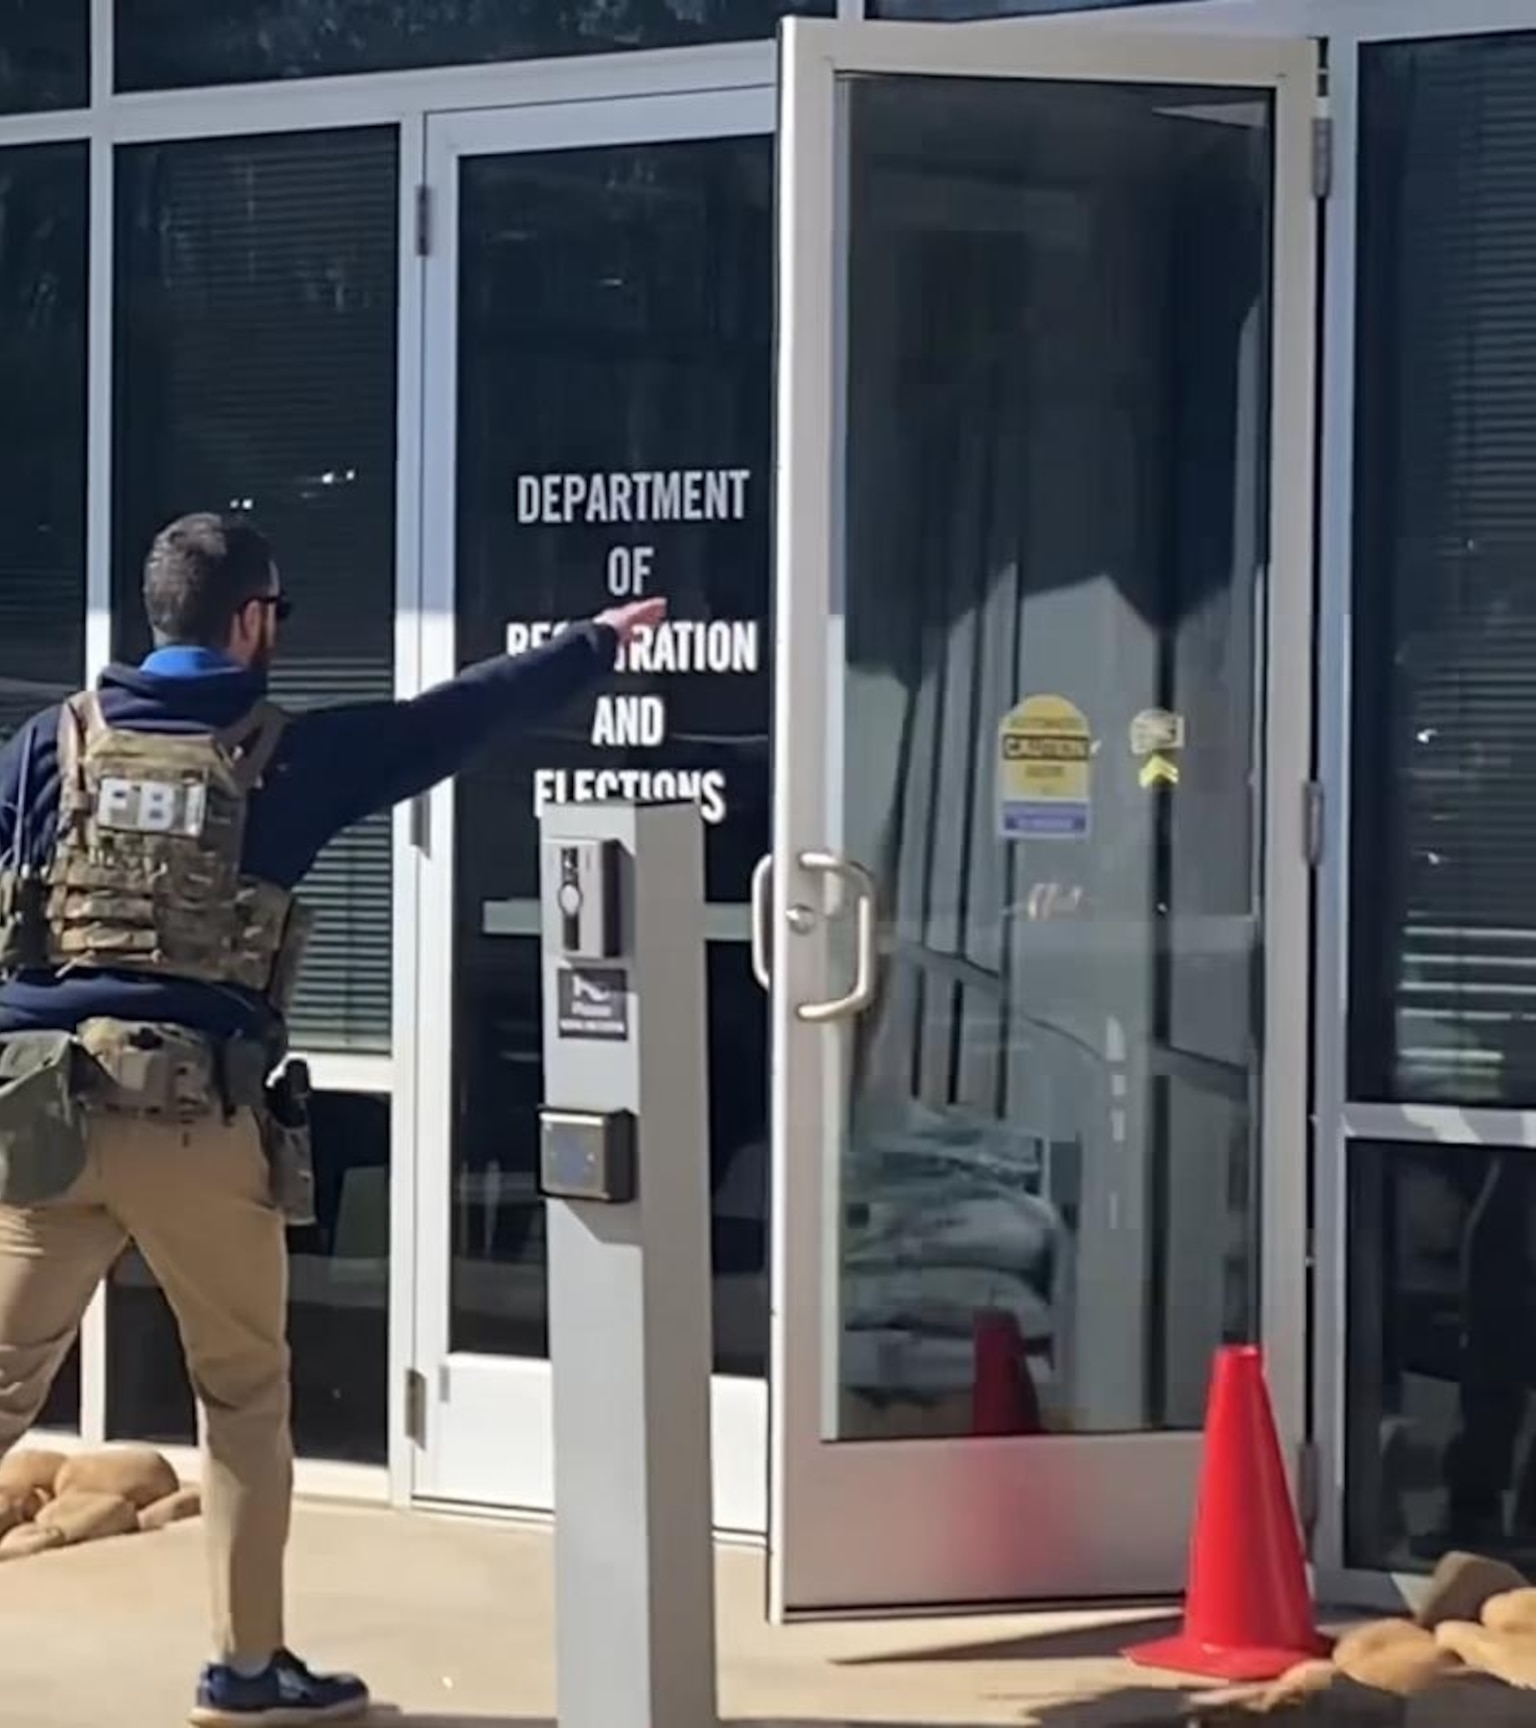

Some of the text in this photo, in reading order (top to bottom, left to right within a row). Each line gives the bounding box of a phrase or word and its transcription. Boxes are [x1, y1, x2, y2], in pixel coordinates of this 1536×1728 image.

[517, 469, 750, 524] DEPARTMENT
[608, 546, 654, 596] OF
[591, 696, 664, 746] AND
[98, 778, 206, 836] FBI
